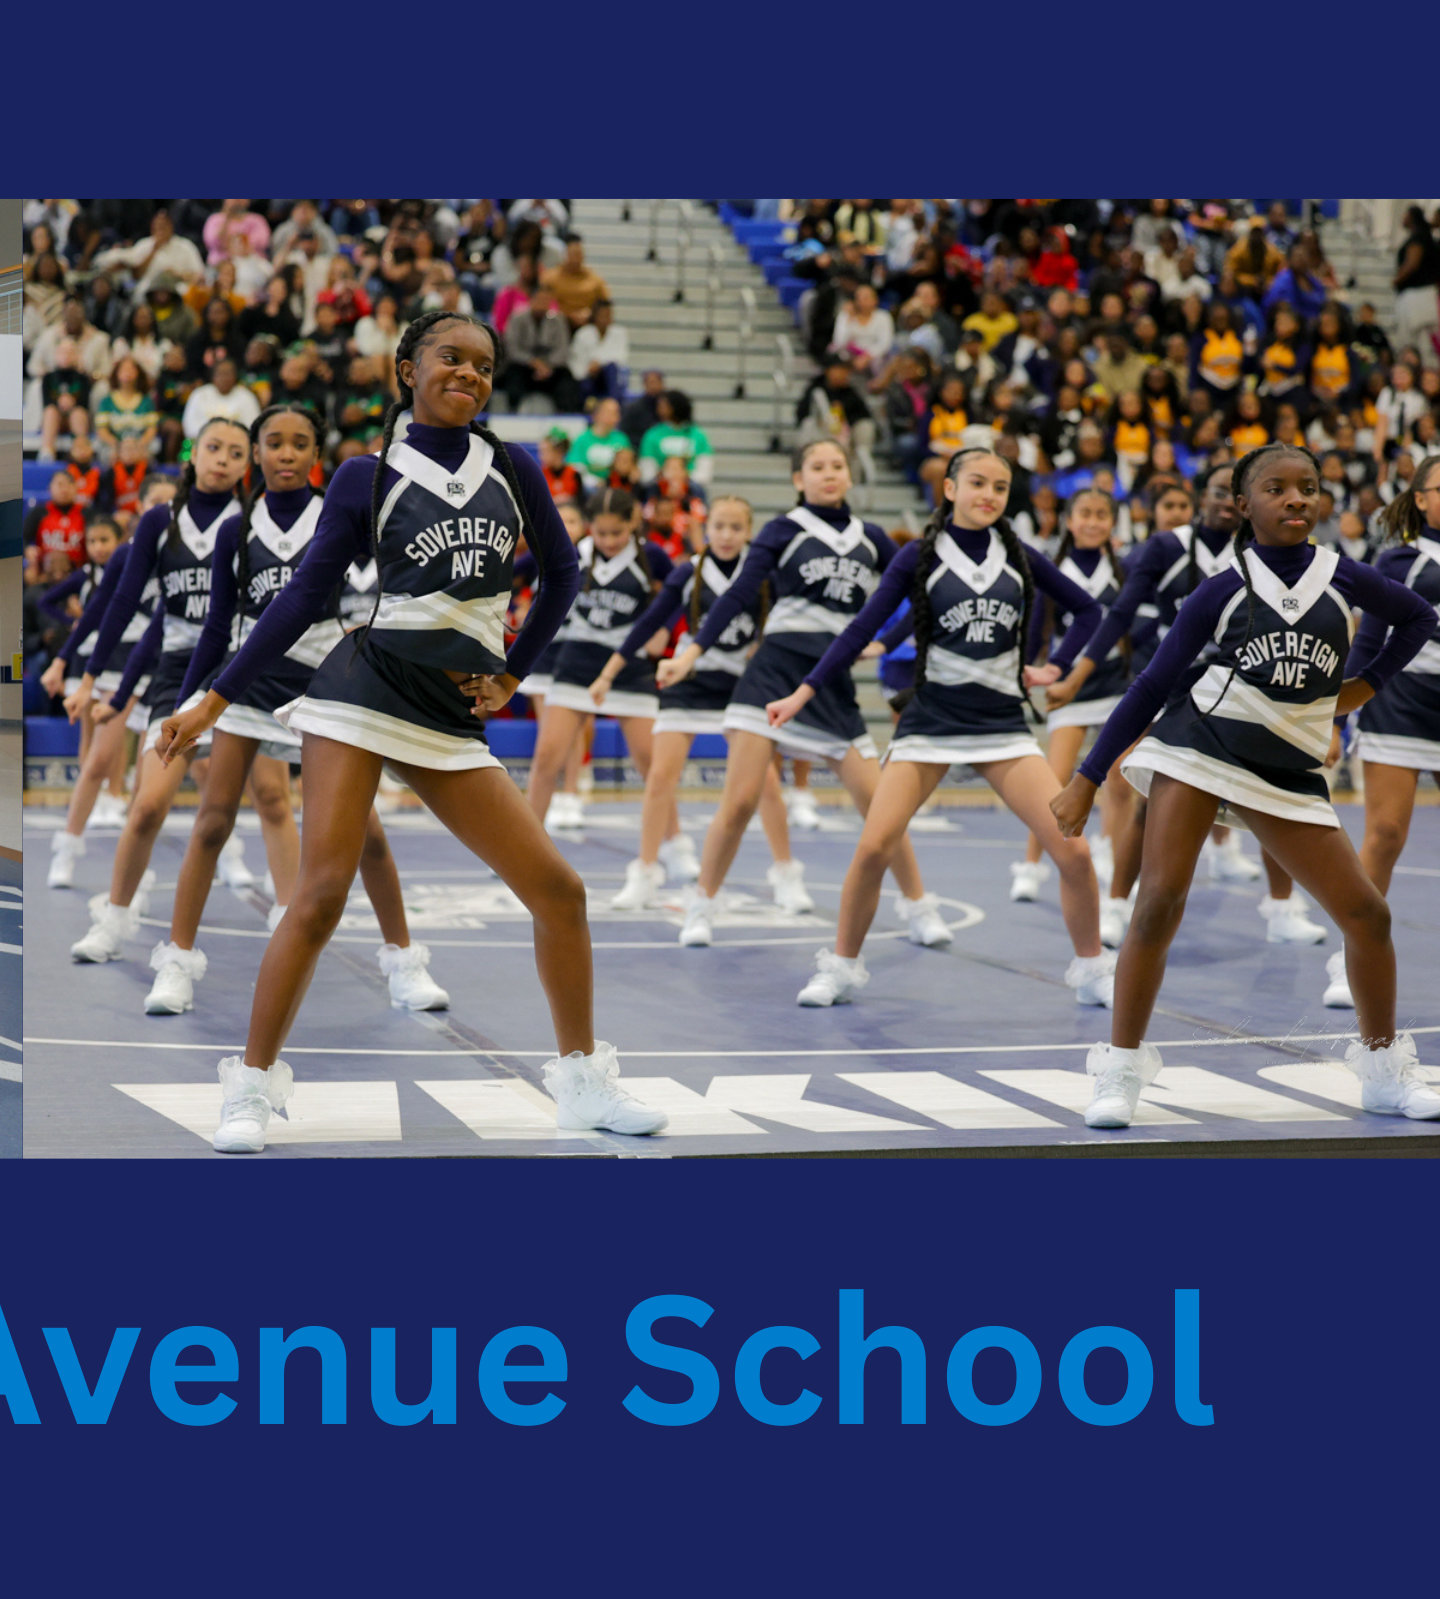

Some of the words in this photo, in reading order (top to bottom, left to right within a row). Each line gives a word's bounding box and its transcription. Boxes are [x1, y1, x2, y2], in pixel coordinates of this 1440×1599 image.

[404, 517, 515, 567] SOVEREIGN
[451, 549, 487, 580] AVE
[247, 566, 298, 604] SOVER
[822, 578, 855, 603] AVE
[965, 620, 996, 643] AVE
[1235, 631, 1339, 678] SOVEREIGN
[1270, 661, 1309, 689] AVE
